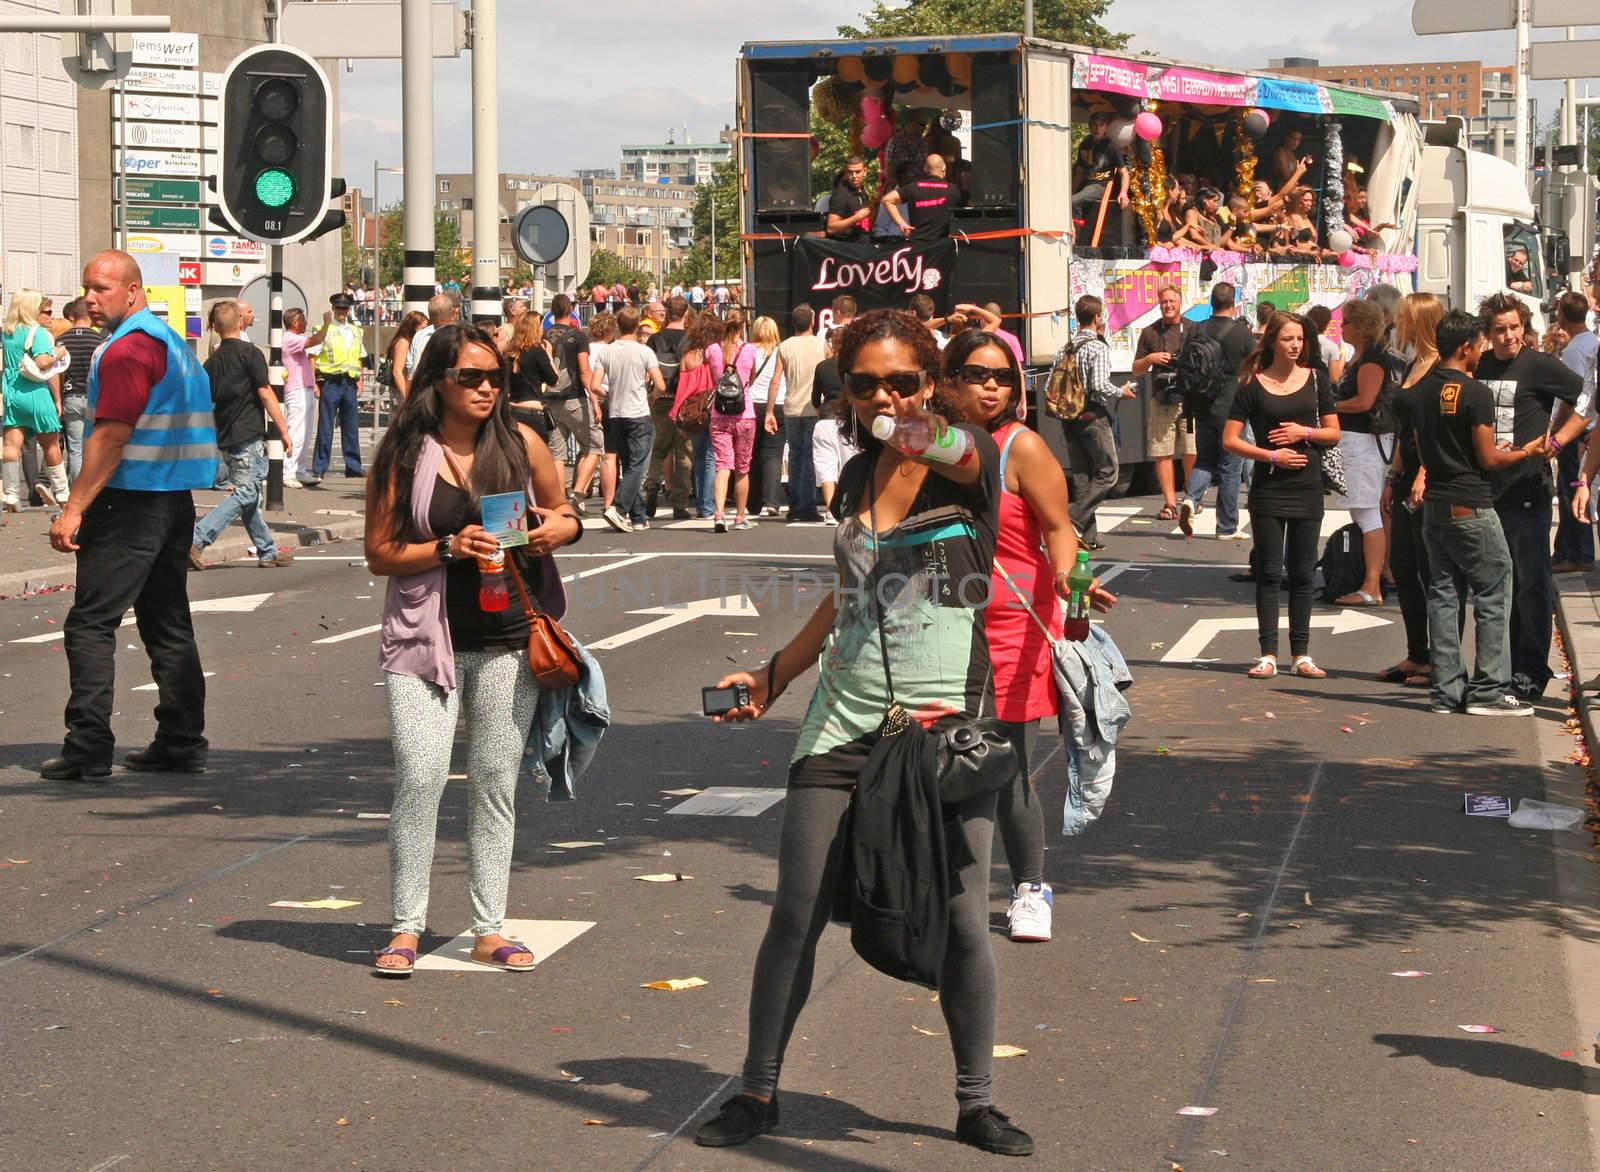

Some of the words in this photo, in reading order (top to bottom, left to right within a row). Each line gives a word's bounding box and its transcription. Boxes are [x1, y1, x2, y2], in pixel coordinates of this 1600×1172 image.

[265, 220, 281, 231] 08.1
[231, 241, 265, 251] TAMOIL
[811, 246, 923, 293] Lovely
